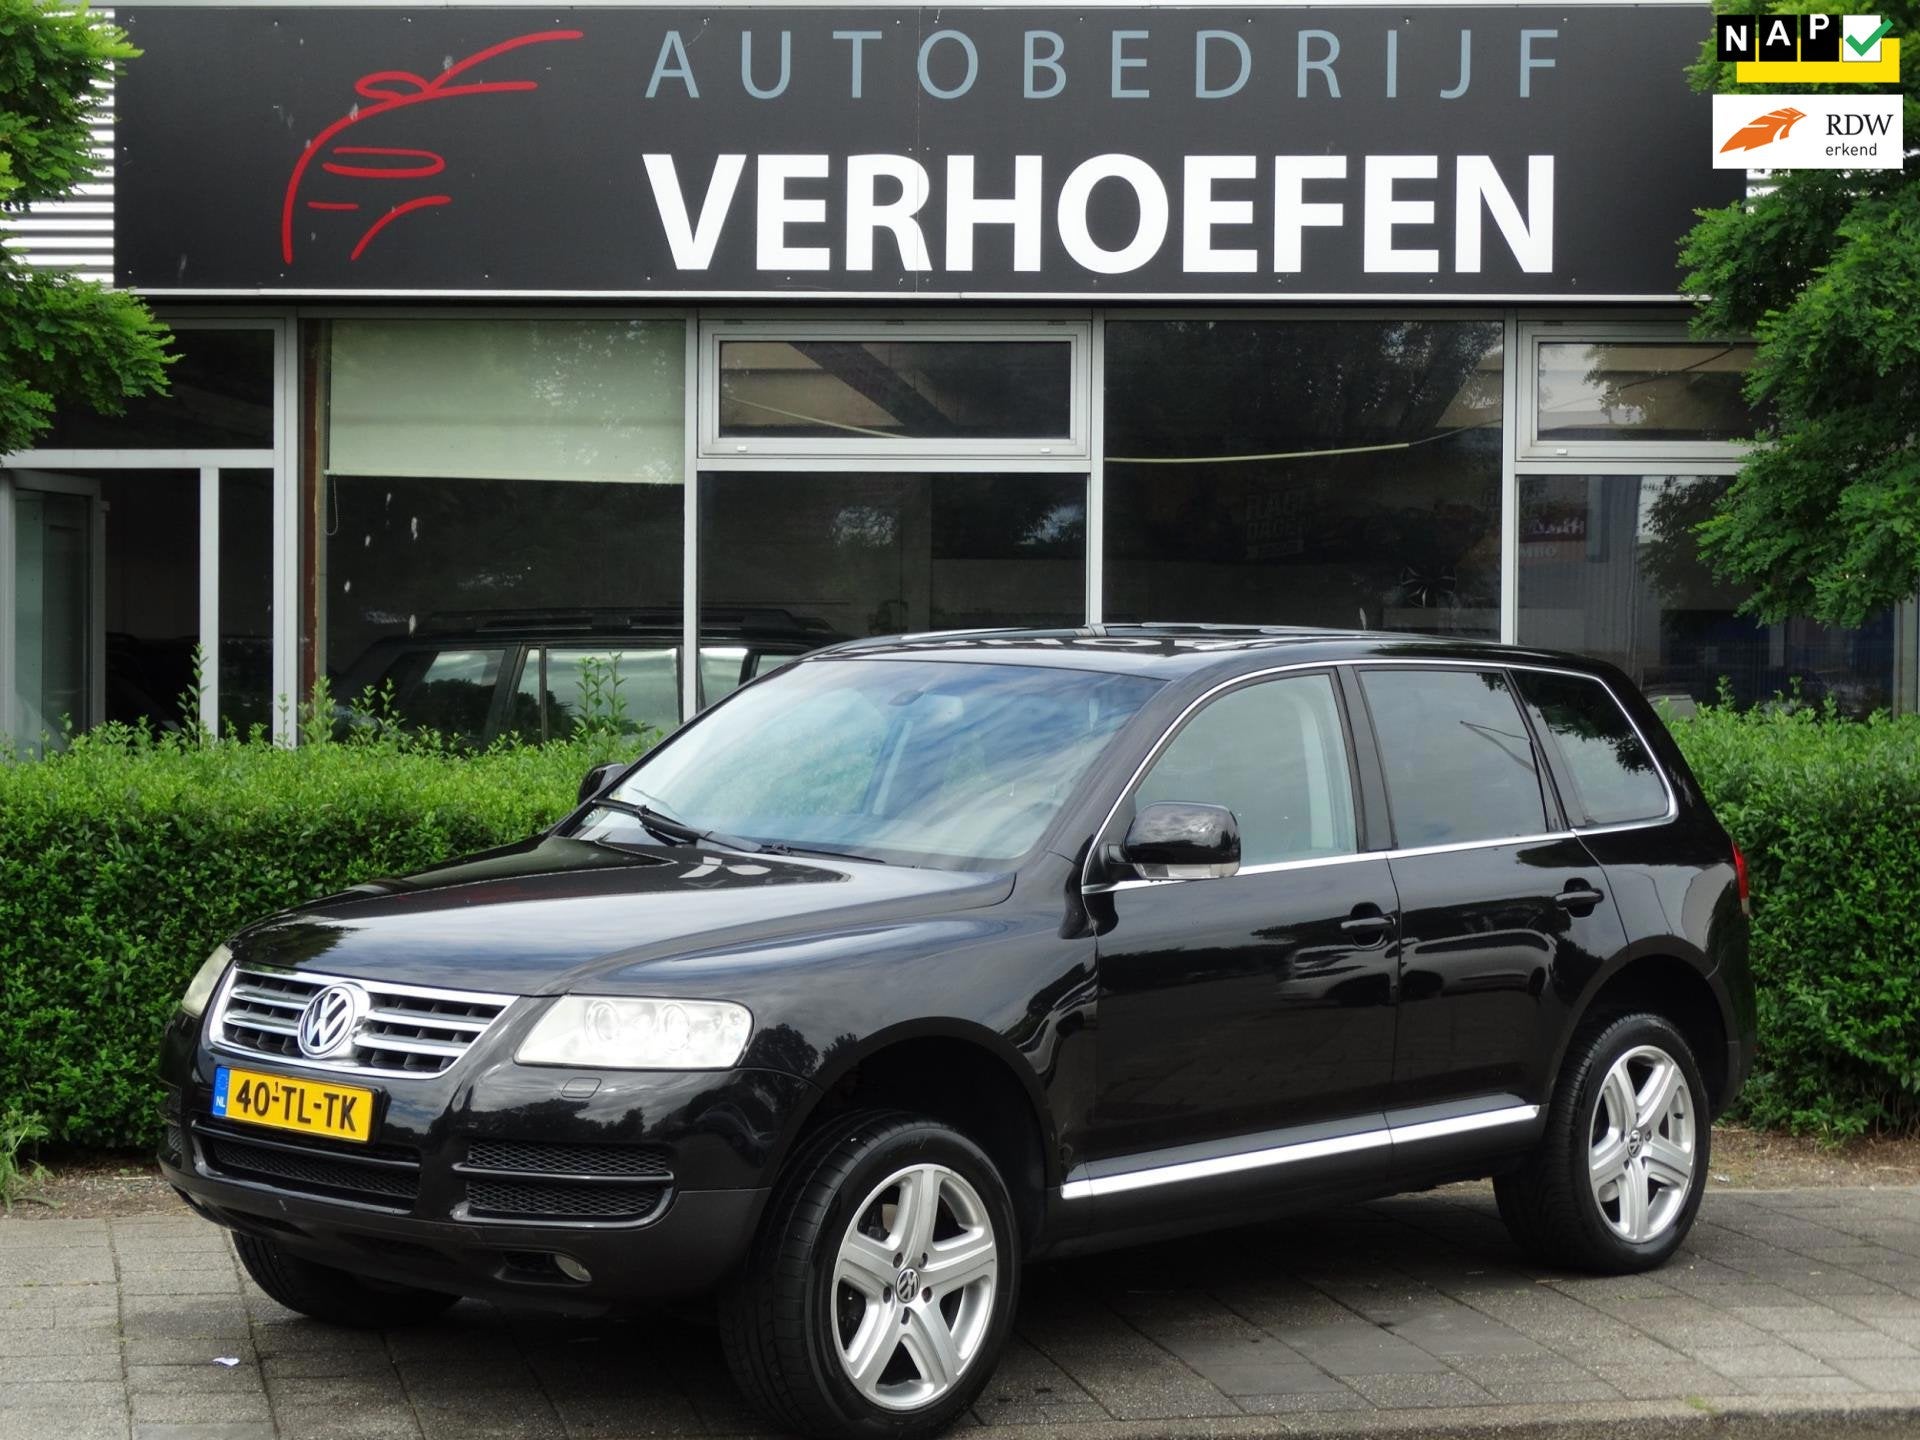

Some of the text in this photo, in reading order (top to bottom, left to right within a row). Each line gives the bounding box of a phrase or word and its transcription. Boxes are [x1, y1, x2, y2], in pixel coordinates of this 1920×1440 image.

[645, 29, 1559, 99] AUTOBEDRIJF
[641, 152, 1556, 275] VERHOEFEN
[215, 1097, 226, 1108] NL
[235, 1078, 358, 1132] 40-TL-TK
